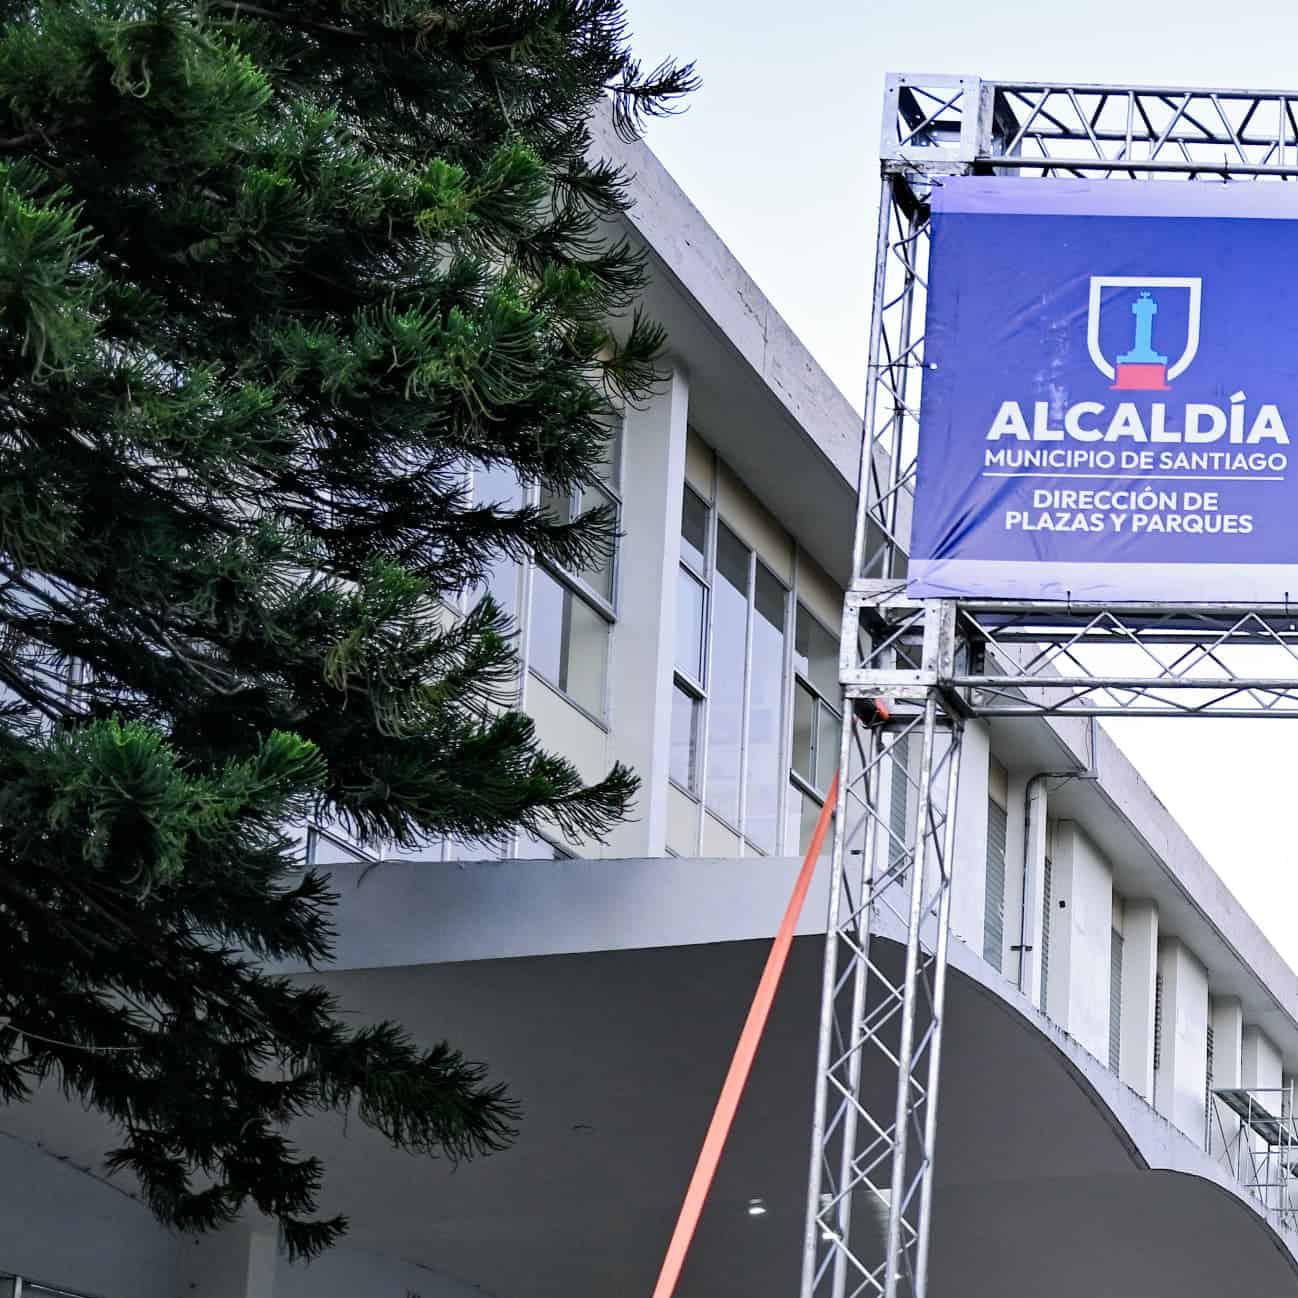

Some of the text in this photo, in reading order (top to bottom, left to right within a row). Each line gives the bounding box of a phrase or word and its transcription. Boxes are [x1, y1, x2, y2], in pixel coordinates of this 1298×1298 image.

[985, 391, 1291, 445] ALCALDÍA
[984, 449, 1288, 472] MUNICIPIO DE SANTIAGO
[1033, 485, 1219, 512] DIRECCIÓN DE
[1005, 512, 1254, 536] PLAZAS Y PARQUES
